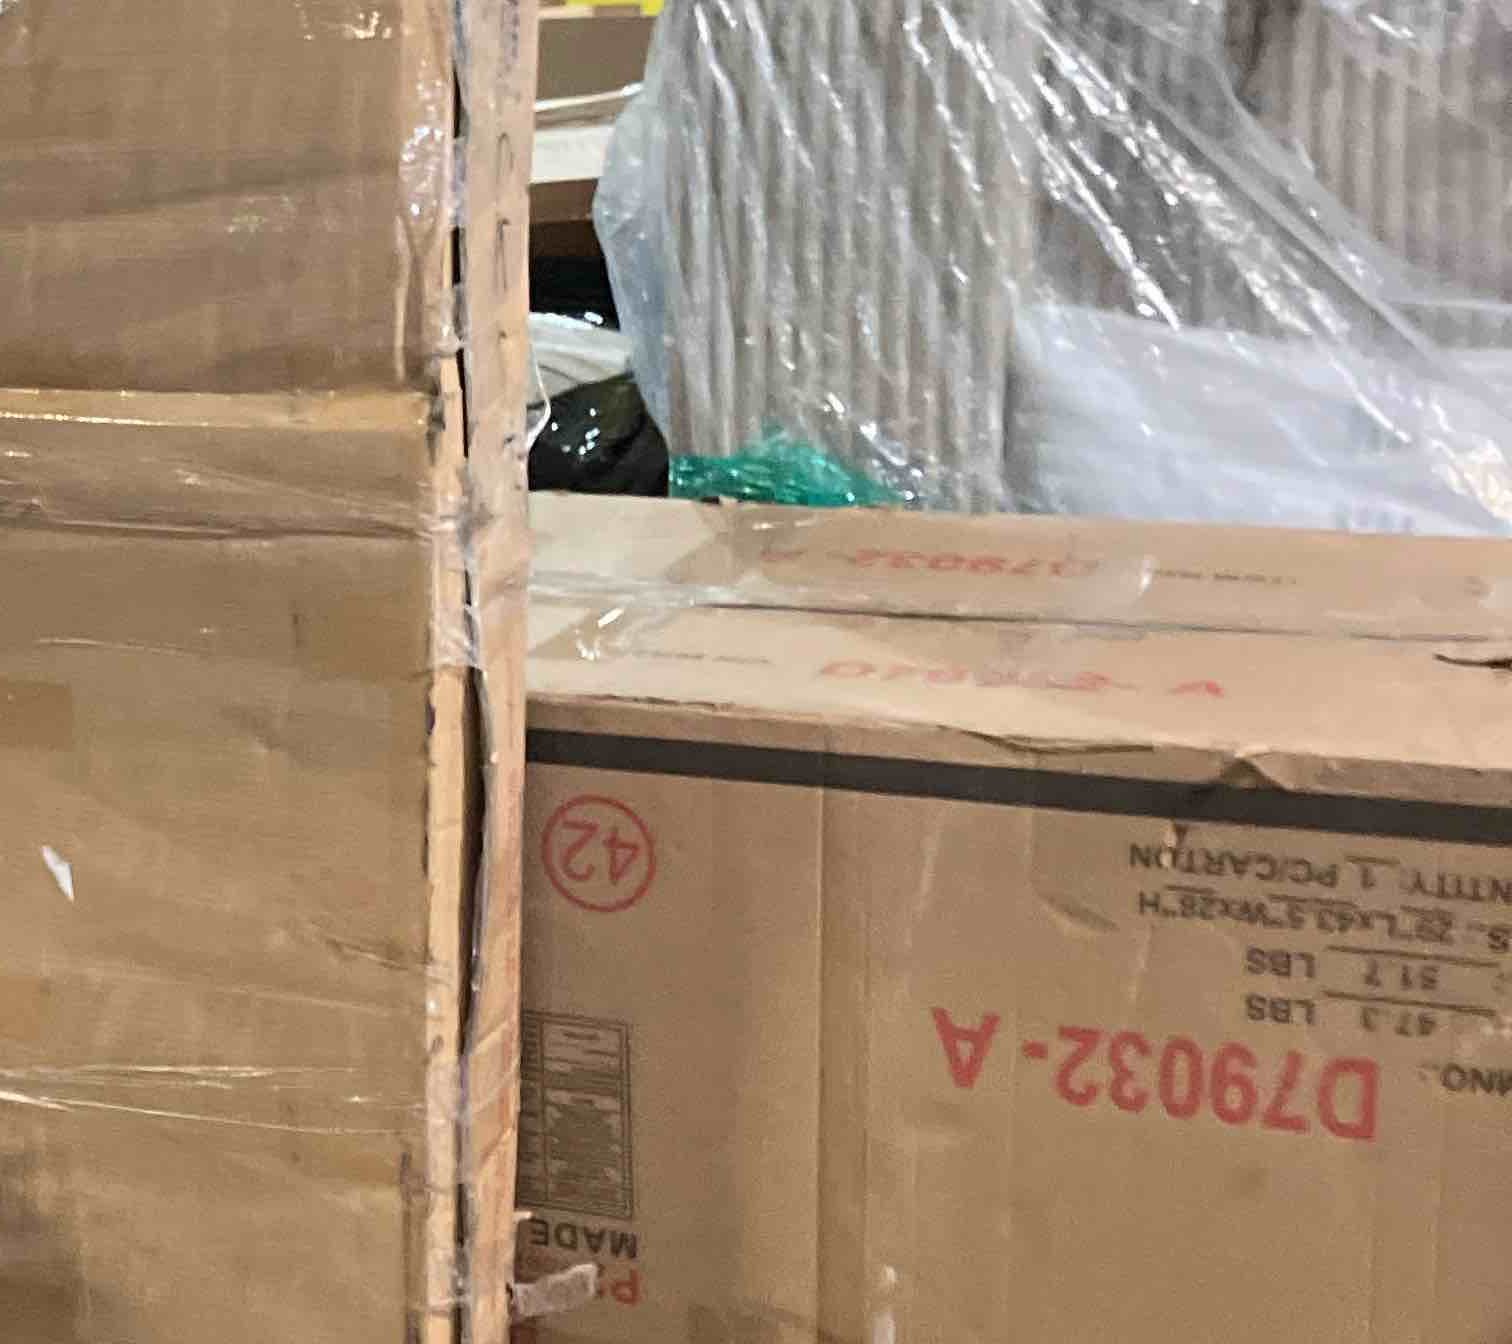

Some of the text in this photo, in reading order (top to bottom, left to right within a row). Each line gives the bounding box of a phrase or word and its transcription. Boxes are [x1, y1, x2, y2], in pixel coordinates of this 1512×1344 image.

[560, 820, 640, 888] 42
[1128, 843, 1339, 890] PC/CARTON
[1244, 946, 1317, 979] LBS
[1244, 993, 1317, 1027] LBS
[528, 1217, 639, 1260] MADE
